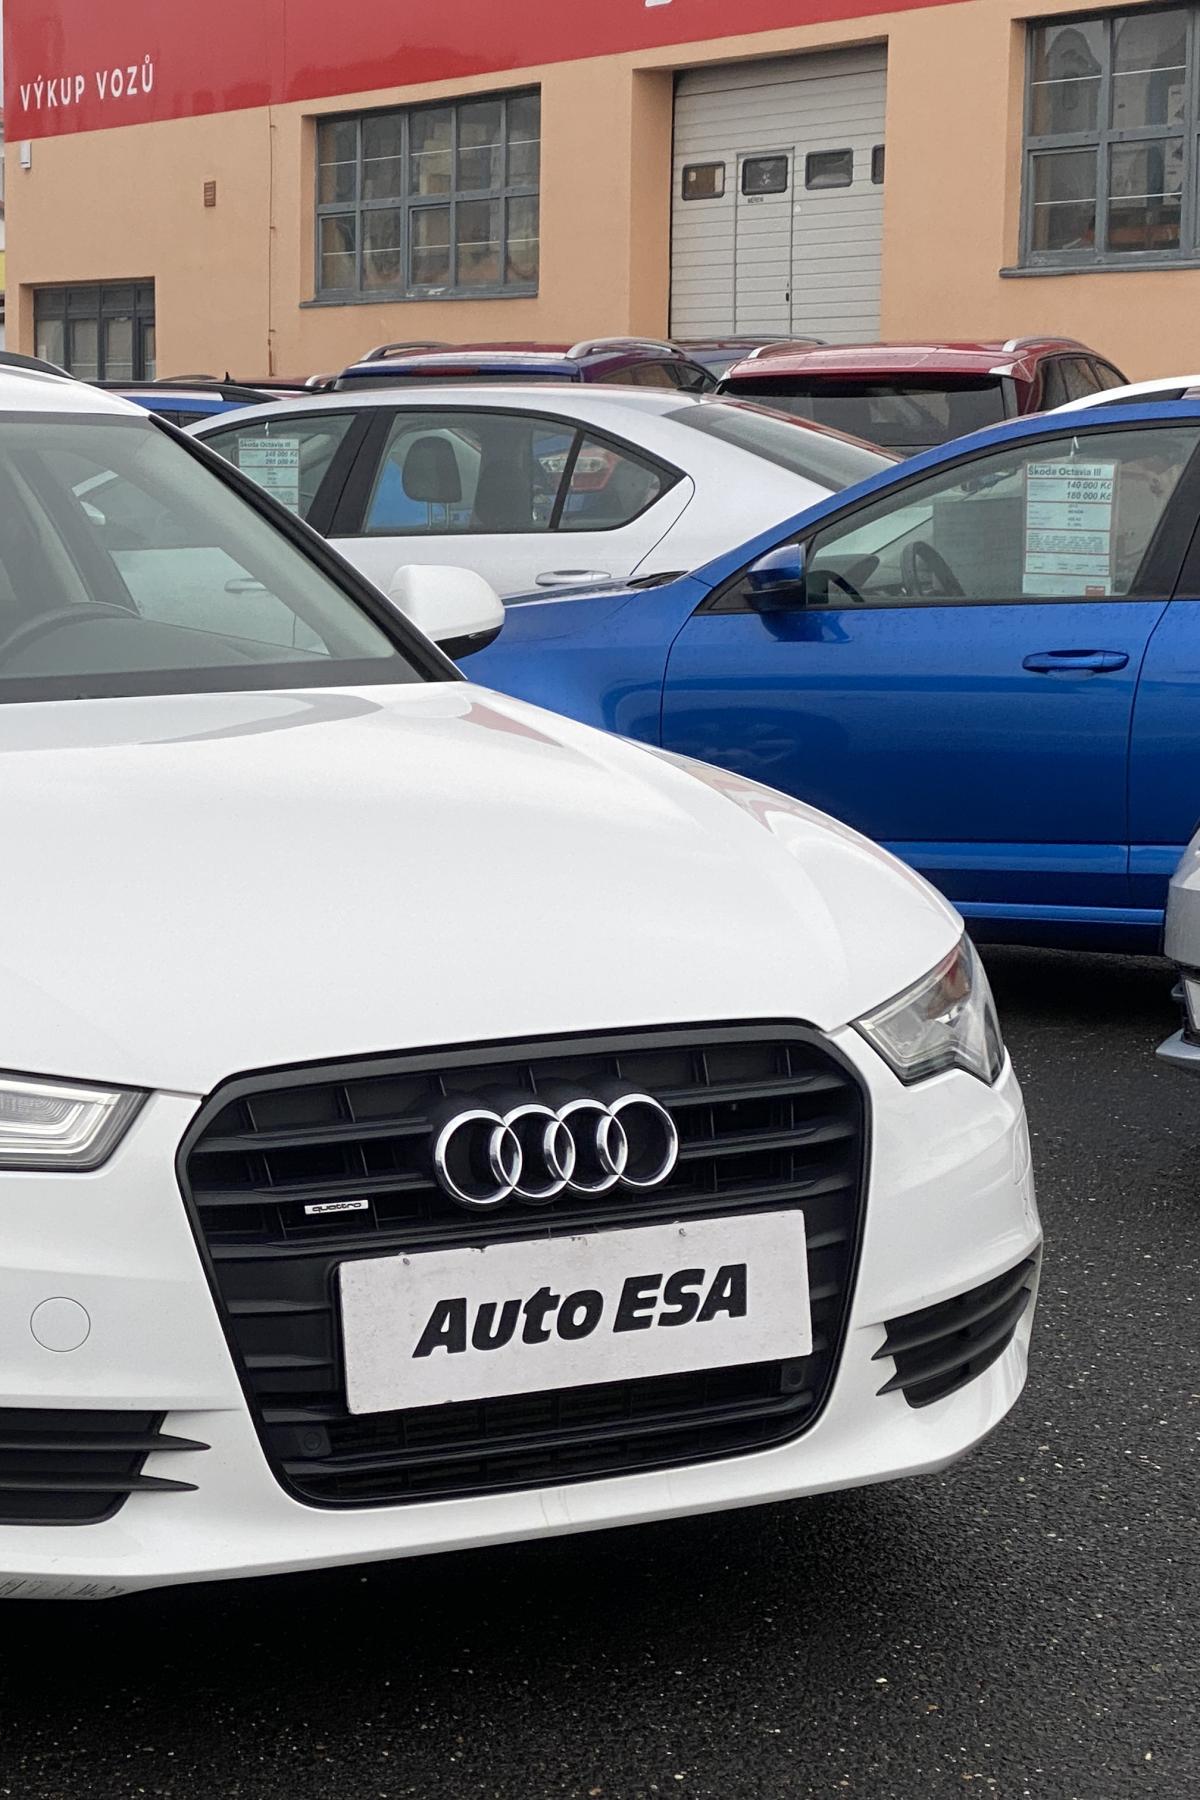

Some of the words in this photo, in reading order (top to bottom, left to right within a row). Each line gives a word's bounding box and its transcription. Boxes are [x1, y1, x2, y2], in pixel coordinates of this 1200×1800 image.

[20, 74, 85, 111] VÝKUP
[96, 54, 153, 100] VOZŮ
[1058, 467, 1092, 476] Octavia
[1093, 468, 1102, 477] III
[1067, 481, 1081, 490] 140
[1082, 481, 1098, 490] 000
[1082, 492, 1098, 500] 000
[311, 1202, 362, 1213] quattro
[411, 1286, 604, 1359] Auto
[612, 1262, 747, 1333] ESA
